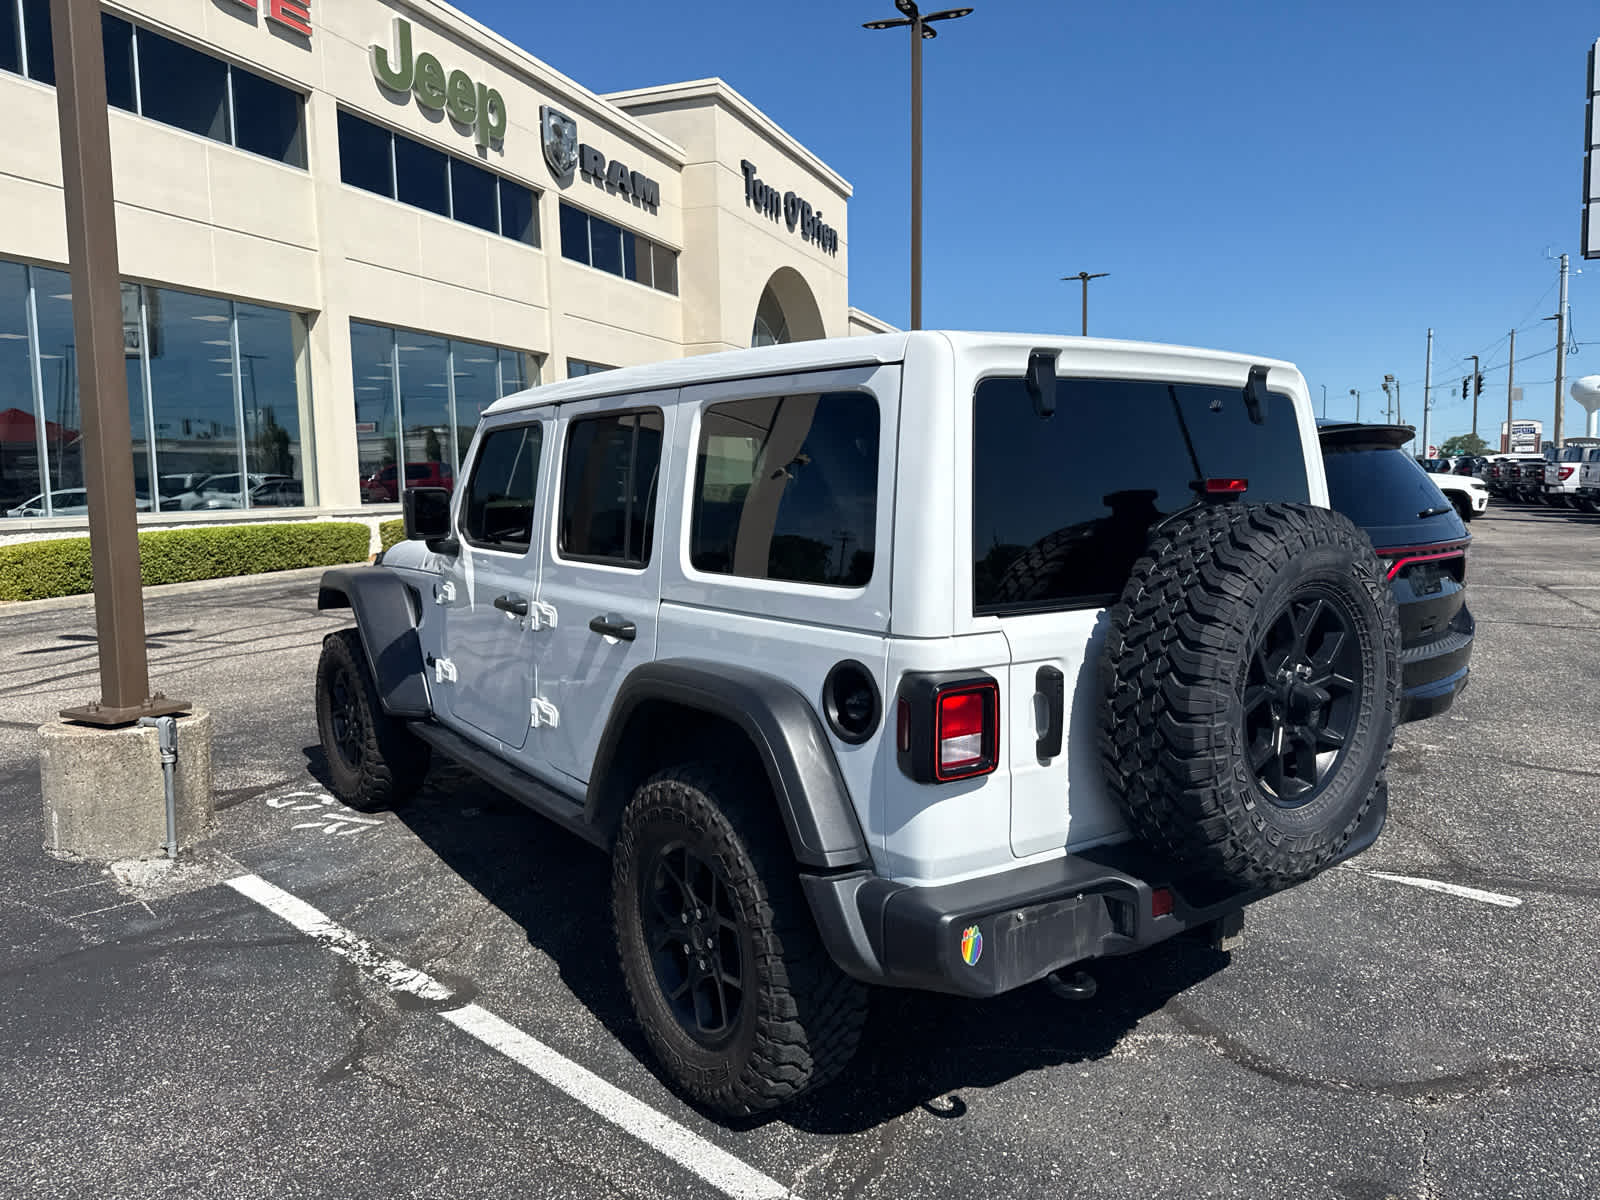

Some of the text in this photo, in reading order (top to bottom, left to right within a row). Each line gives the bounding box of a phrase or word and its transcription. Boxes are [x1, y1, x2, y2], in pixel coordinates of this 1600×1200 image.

[368, 17, 507, 147] Jeep
[579, 143, 660, 208] RAM
[740, 159, 838, 253] Tom O'Brien
